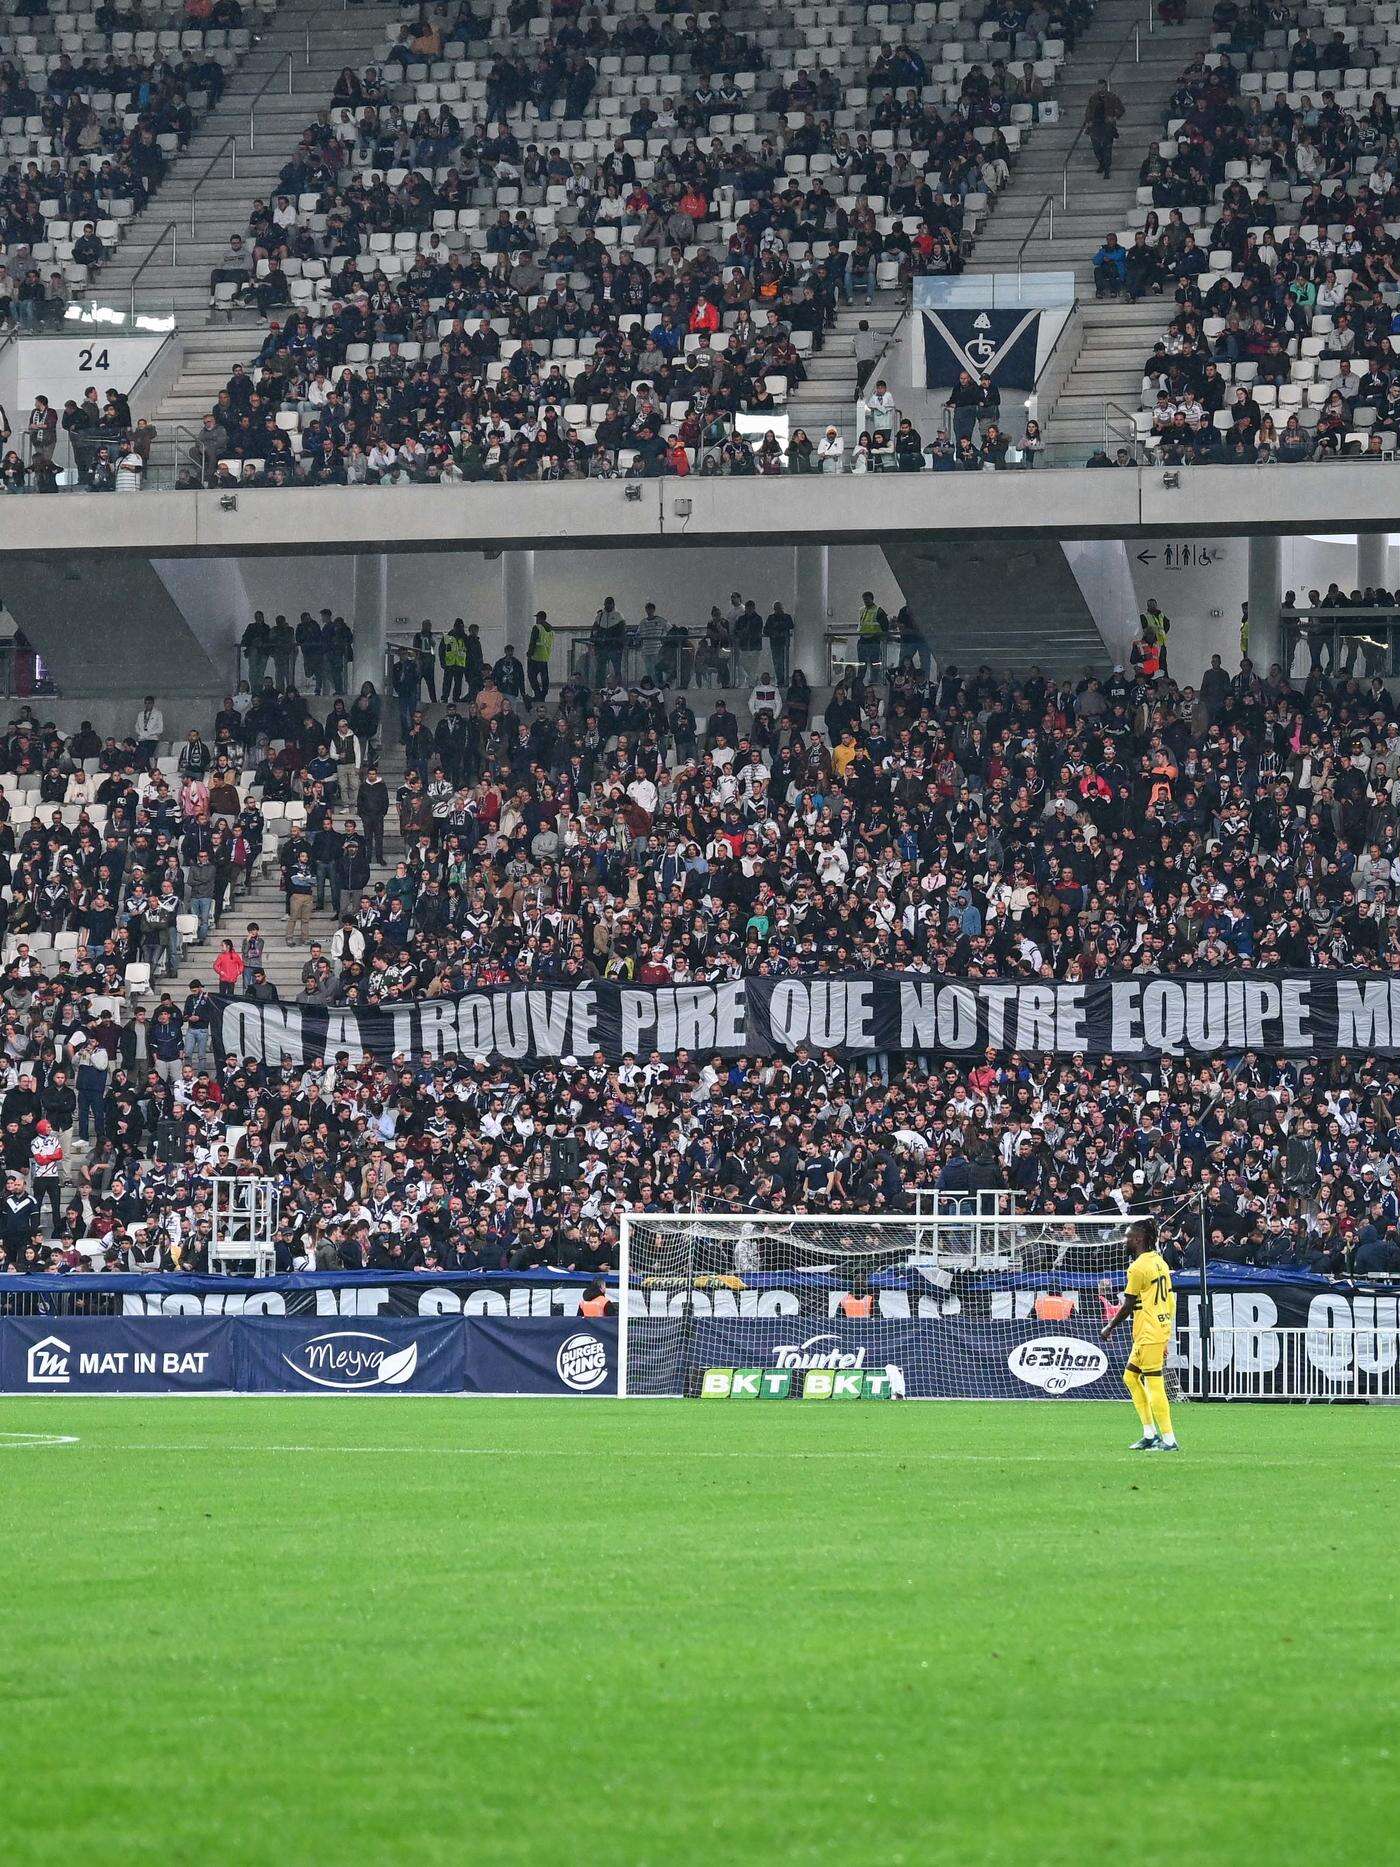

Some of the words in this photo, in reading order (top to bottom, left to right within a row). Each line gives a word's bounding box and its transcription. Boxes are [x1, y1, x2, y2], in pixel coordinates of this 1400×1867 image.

[79, 349, 110, 371] 24
[222, 1001, 304, 1068] ON
[323, 1006, 364, 1066] A
[379, 979, 601, 1061] TROUVÉ
[620, 980, 747, 1055] PIRE
[769, 979, 876, 1053] QUE
[900, 980, 1089, 1051] NOTRE
[1111, 980, 1314, 1056] EQUIPE
[1151, 1274, 1168, 1305] 70
[79, 1352, 129, 1374] MAT
[134, 1352, 156, 1374] IN
[163, 1352, 210, 1374] BAT
[305, 1343, 385, 1376] Meyva
[562, 1342, 605, 1365] BURGER
[563, 1352, 606, 1379] KING
[772, 1344, 866, 1369] Tourtel
[703, 1374, 789, 1394] BKT
[806, 1374, 891, 1395] BKT
